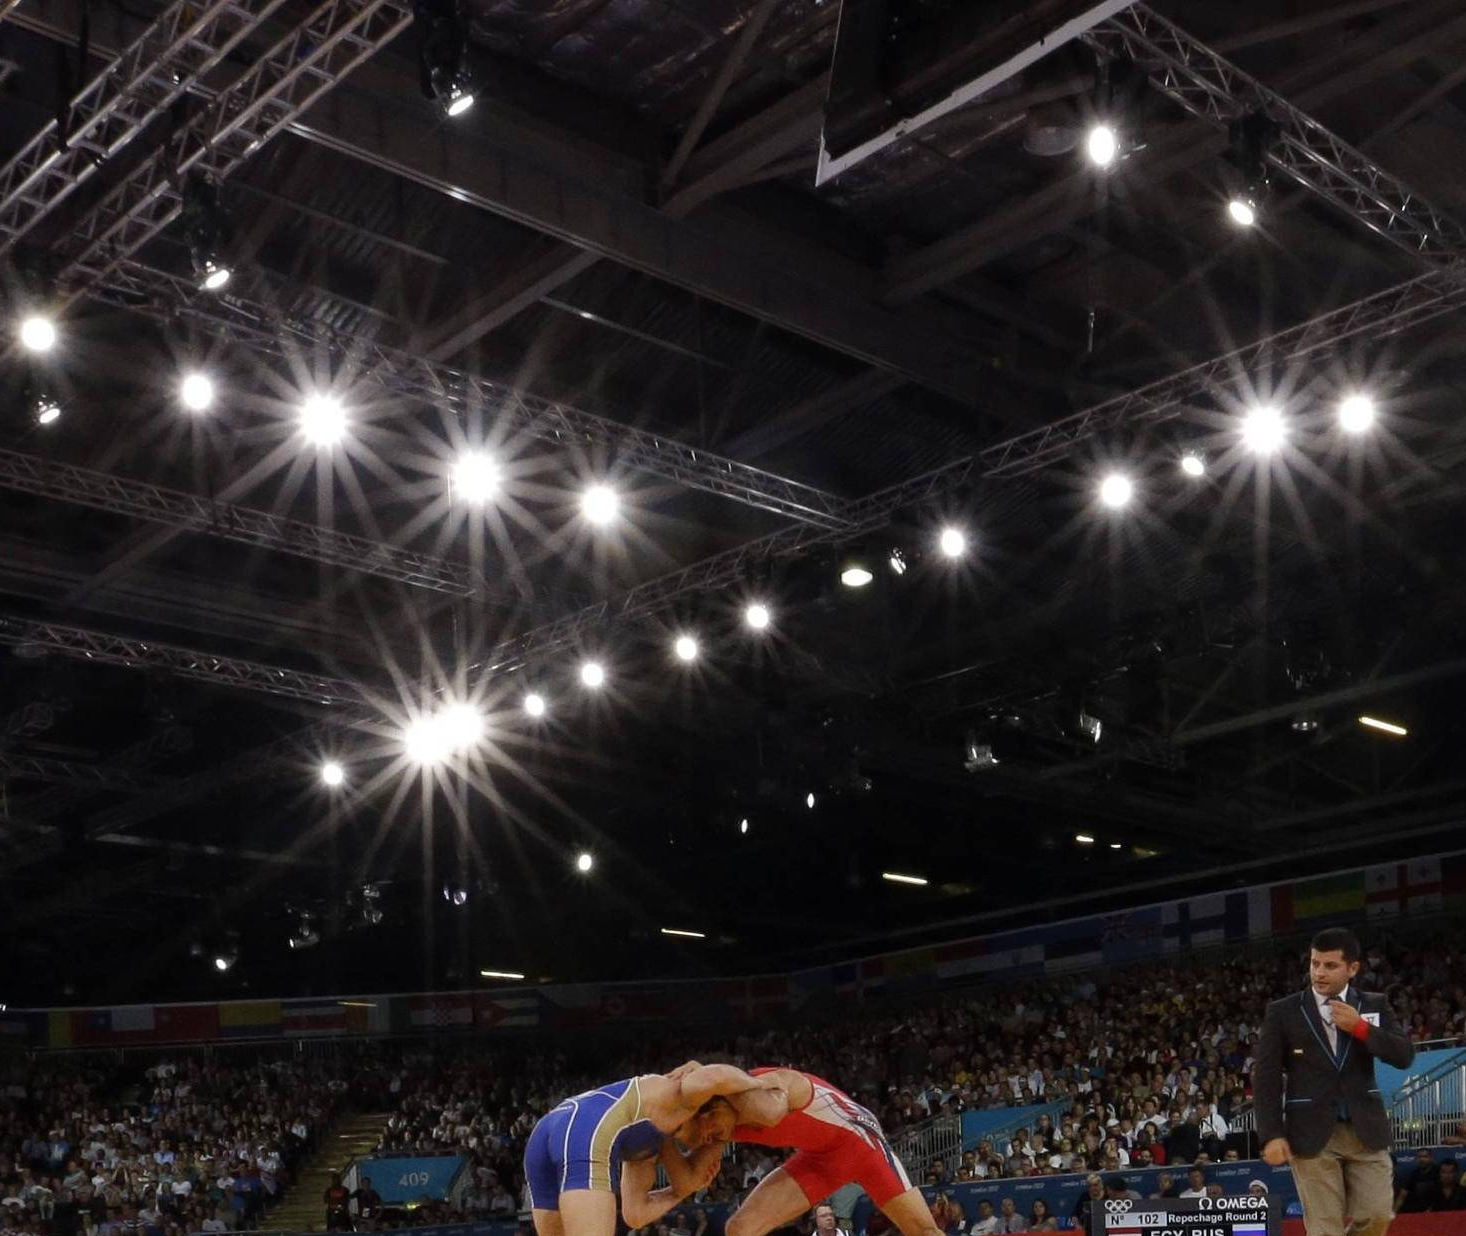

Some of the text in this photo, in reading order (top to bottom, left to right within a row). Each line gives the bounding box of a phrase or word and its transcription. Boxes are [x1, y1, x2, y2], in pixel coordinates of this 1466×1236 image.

[398, 1171, 430, 1187] 409
[1216, 1196, 1269, 1210] OMEGA
[1138, 1214, 1159, 1225] 102
[1168, 1211, 1267, 1226] Repechage Round 2
